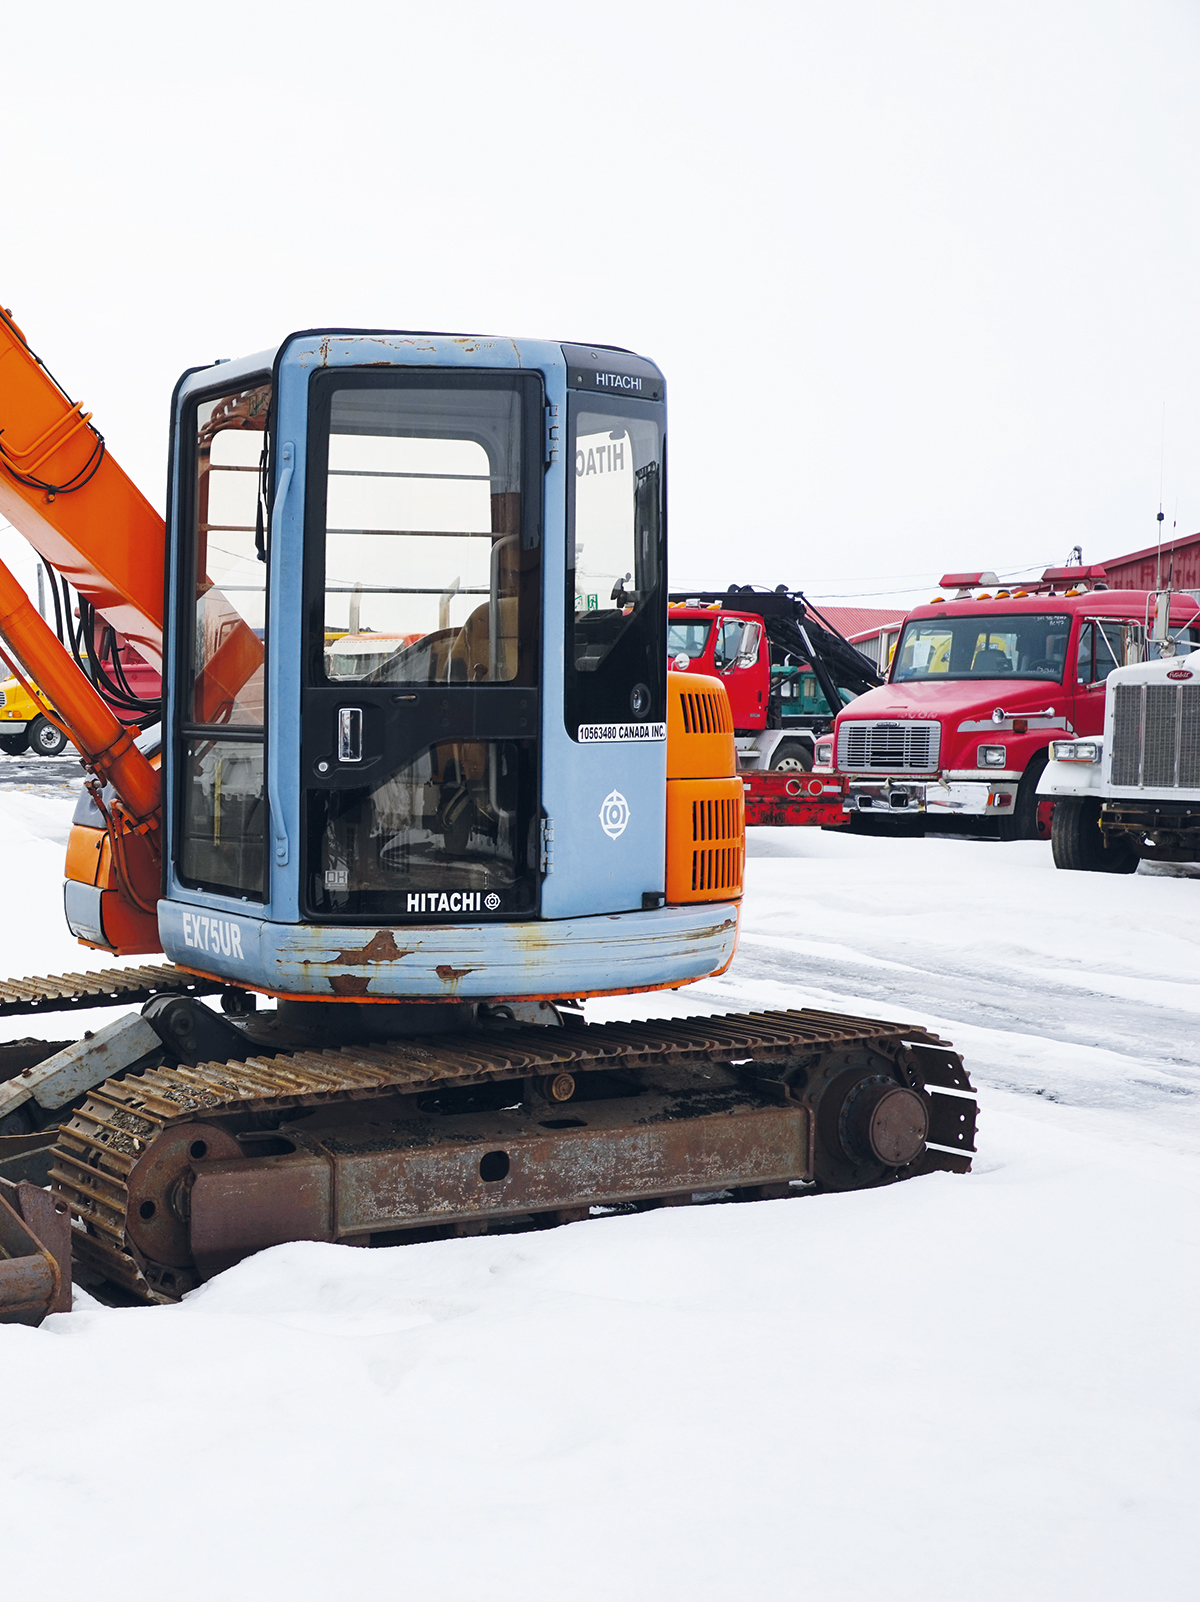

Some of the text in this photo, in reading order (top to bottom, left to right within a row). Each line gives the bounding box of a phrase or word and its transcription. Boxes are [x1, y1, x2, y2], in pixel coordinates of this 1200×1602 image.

[596, 372, 642, 390] HITACHI
[580, 725, 665, 740] 10563480 CANADA INC.
[406, 892, 481, 912] HITACHI
[182, 912, 244, 960] EX75UR
